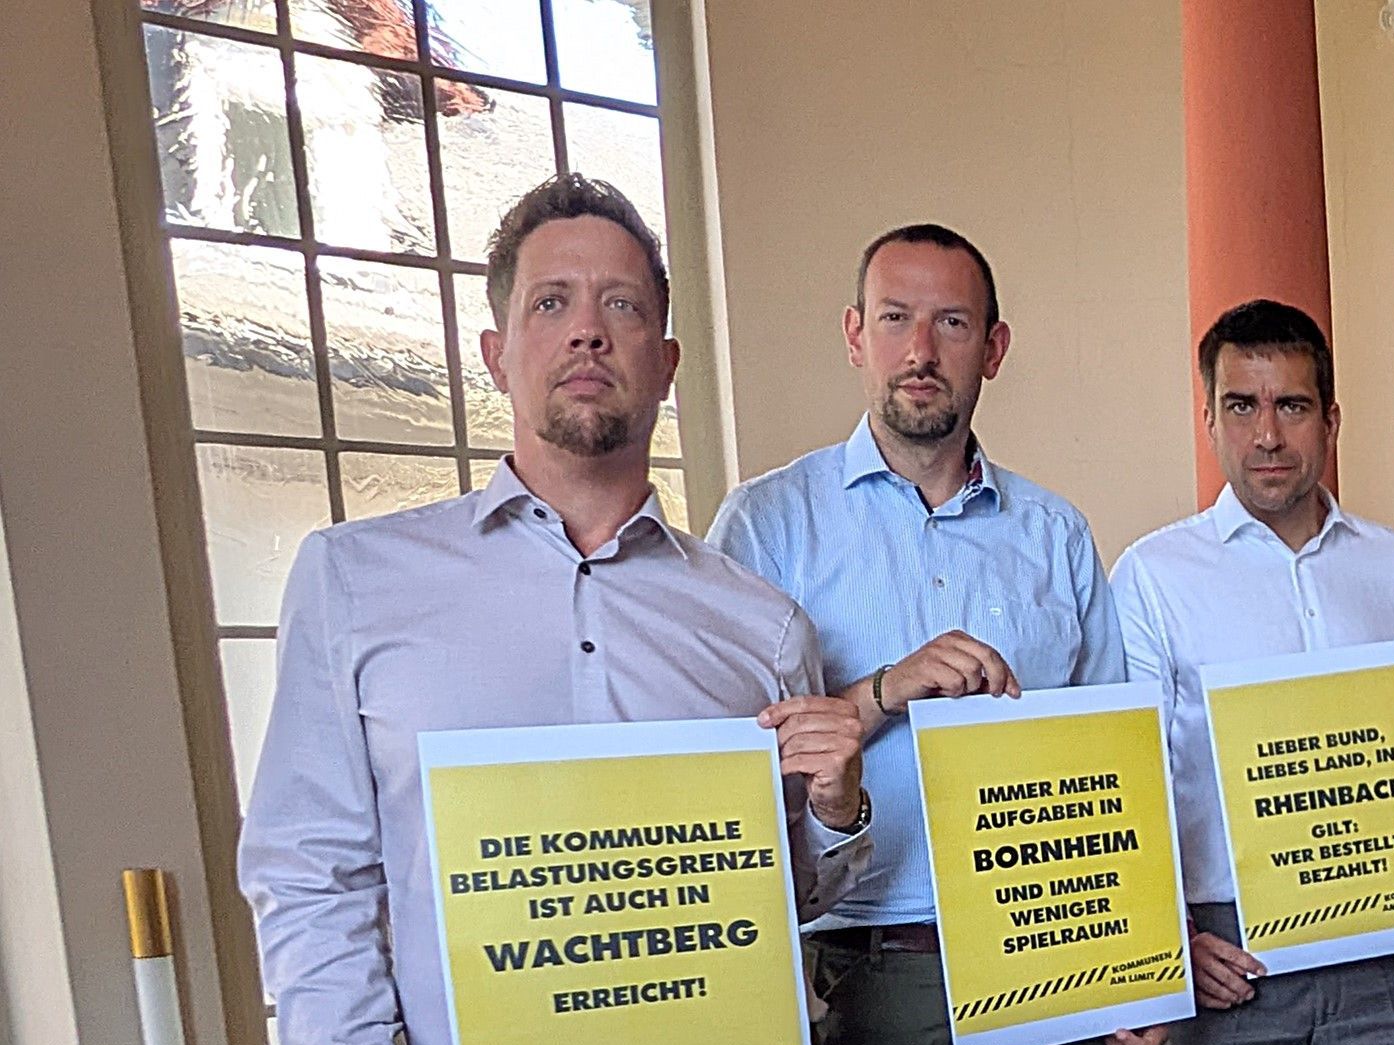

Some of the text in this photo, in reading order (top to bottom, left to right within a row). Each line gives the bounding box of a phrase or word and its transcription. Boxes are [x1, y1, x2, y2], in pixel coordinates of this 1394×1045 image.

[1257, 728, 1386, 758] LIEBER BUND,
[1247, 761, 1309, 782] LIEBES
[1314, 753, 1372, 773] LAND,
[979, 773, 1120, 805] IMMER MEHR
[975, 798, 1122, 832] AUFGABEN IN
[1311, 820, 1359, 839] GILT:
[480, 820, 742, 858] DIE KOMMUNALE
[973, 829, 1139, 872] BORNHEIM
[450, 848, 774, 895] BELASTUNGSGRENZE
[1271, 849, 1314, 867] WER
[1299, 858, 1388, 886] BEZAHLT!
[529, 885, 709, 920] IST AUCH IN
[996, 872, 1121, 904] UND IMMER
[1010, 897, 1112, 927] WENIGER
[484, 919, 759, 973] WACHTBERG
[1003, 918, 1129, 955] SPIELRAUM!
[1112, 951, 1172, 974] KOMMUNEN
[1110, 972, 1156, 986] AM LIMIT
[553, 977, 707, 1014] ERREICHT!
